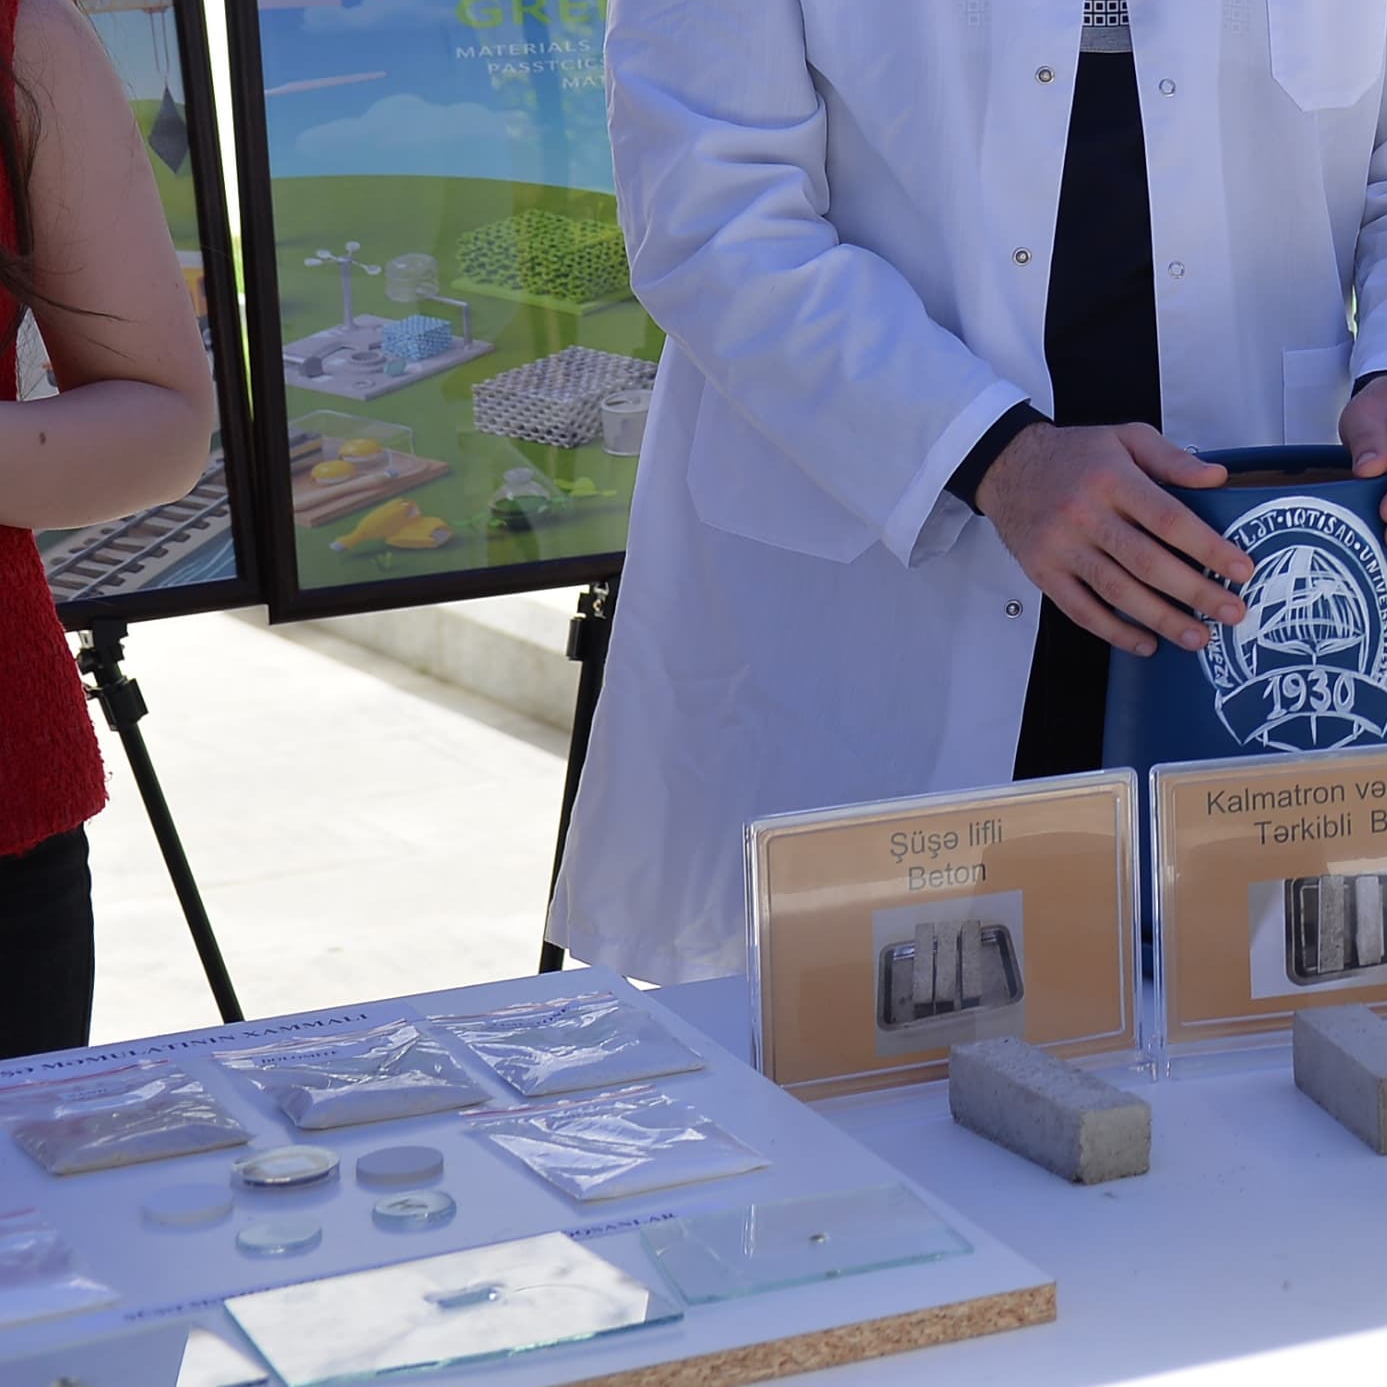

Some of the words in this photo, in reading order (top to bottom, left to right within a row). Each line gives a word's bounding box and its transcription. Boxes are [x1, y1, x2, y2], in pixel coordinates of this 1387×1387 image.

[456, 40, 591, 59] MATERIALS
[1263, 668, 1355, 720] 1930
[1207, 782, 1347, 814] Kalmatron
[1356, 780, 1387, 800] və
[969, 819, 1004, 846] lifli
[1254, 814, 1352, 845] Tərkibli
[907, 861, 987, 892] Beton
